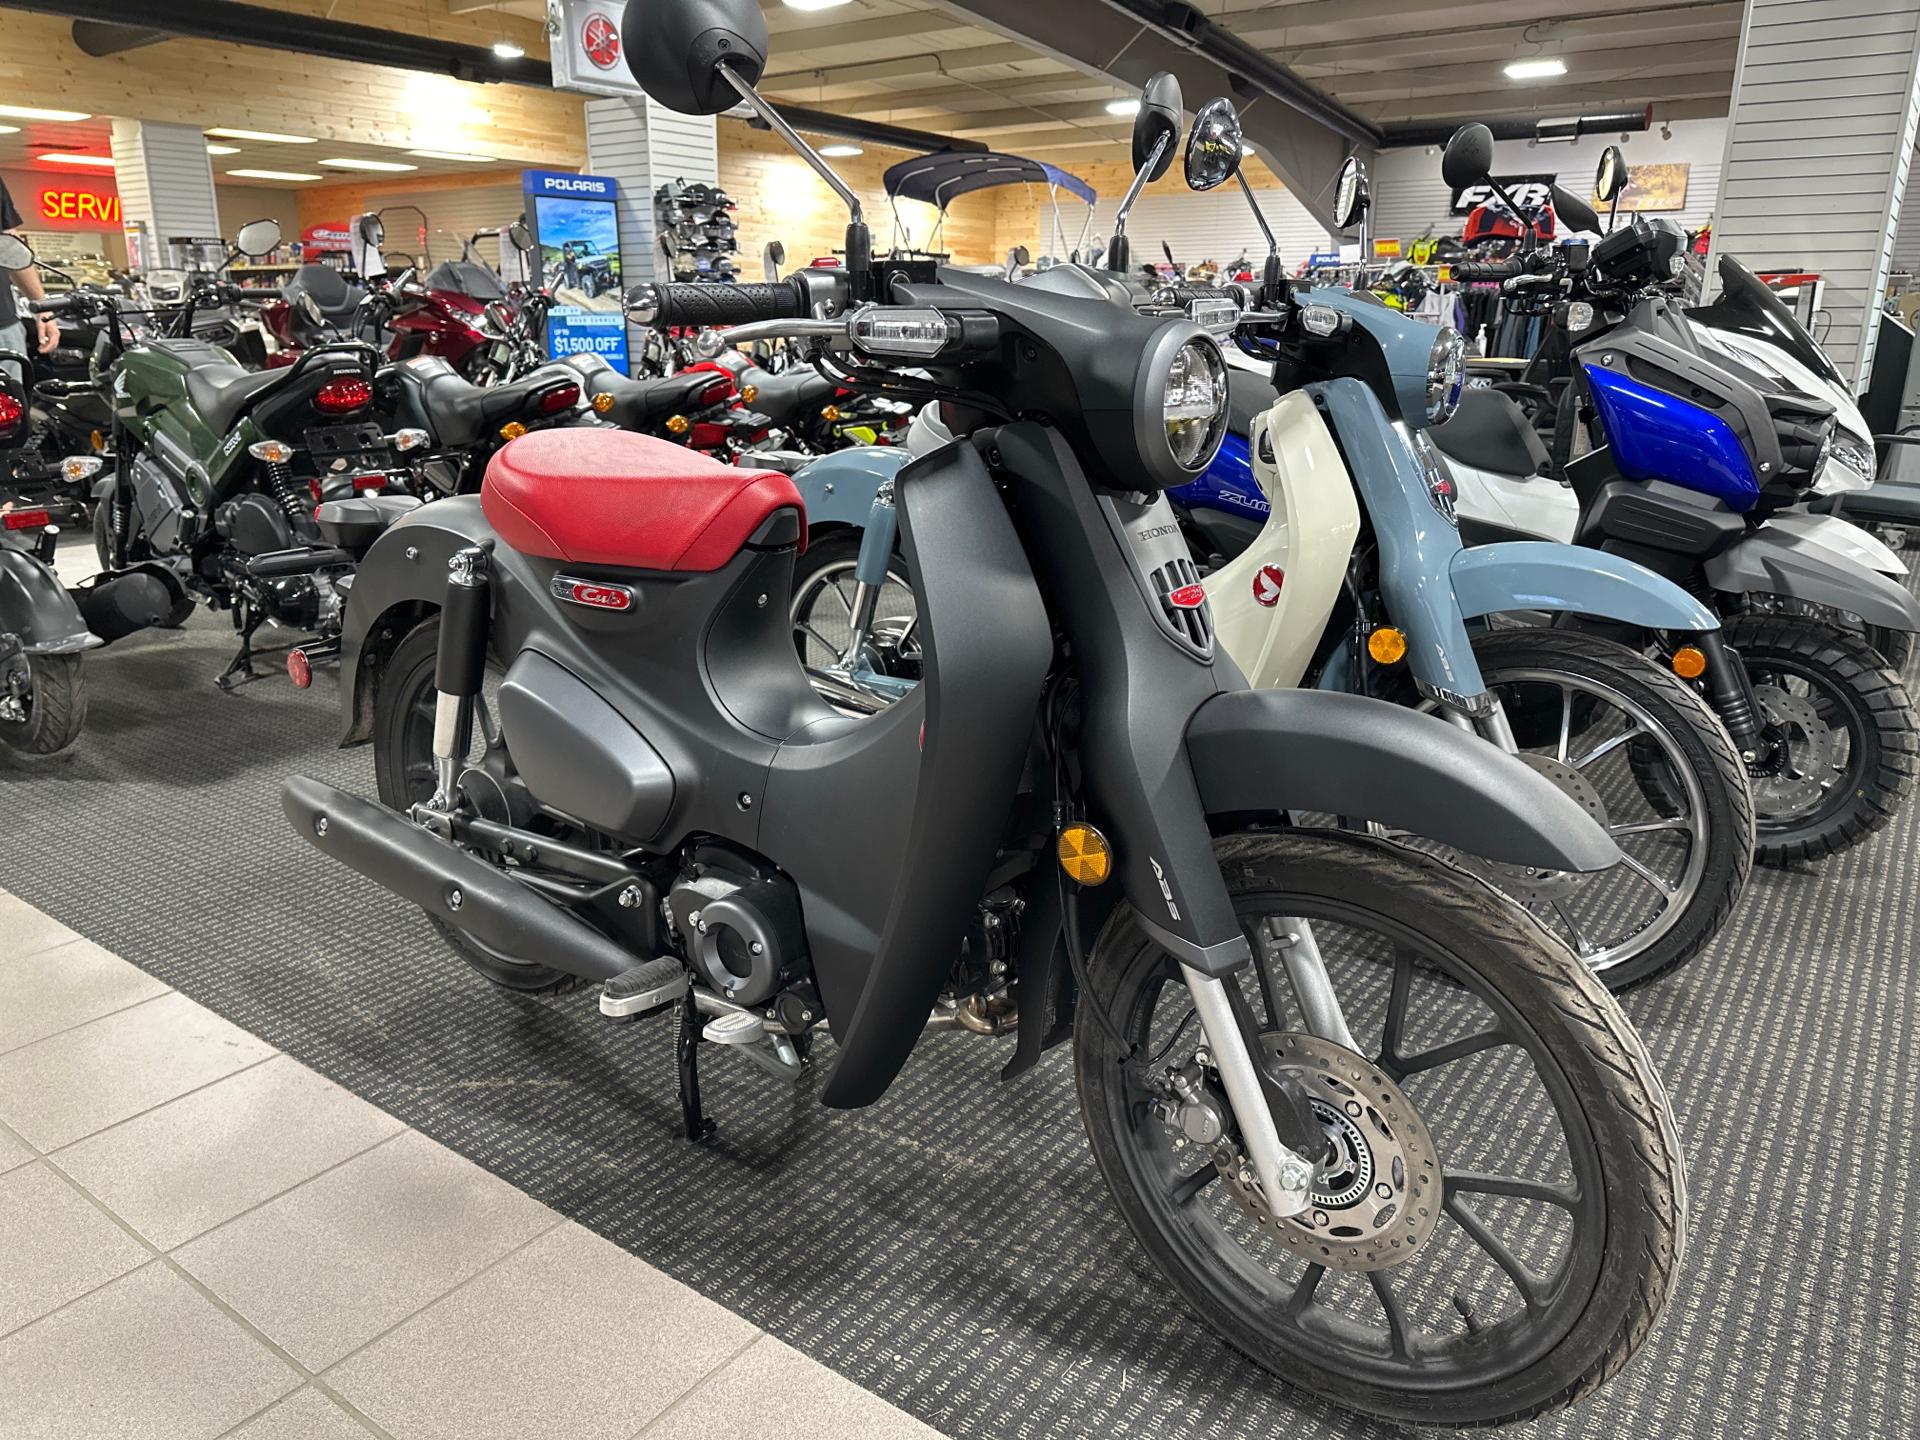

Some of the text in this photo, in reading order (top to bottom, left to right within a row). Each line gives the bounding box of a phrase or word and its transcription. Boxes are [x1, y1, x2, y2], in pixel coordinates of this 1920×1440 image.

[544, 178, 606, 193] POLARIS
[1455, 183, 1551, 208] FXR
[43, 191, 120, 222] SERVI
[554, 336, 594, 354] $1,500
[1138, 525, 1179, 541] HONDA
[581, 588, 621, 605] Cub
[1149, 855, 1181, 921] ABS
